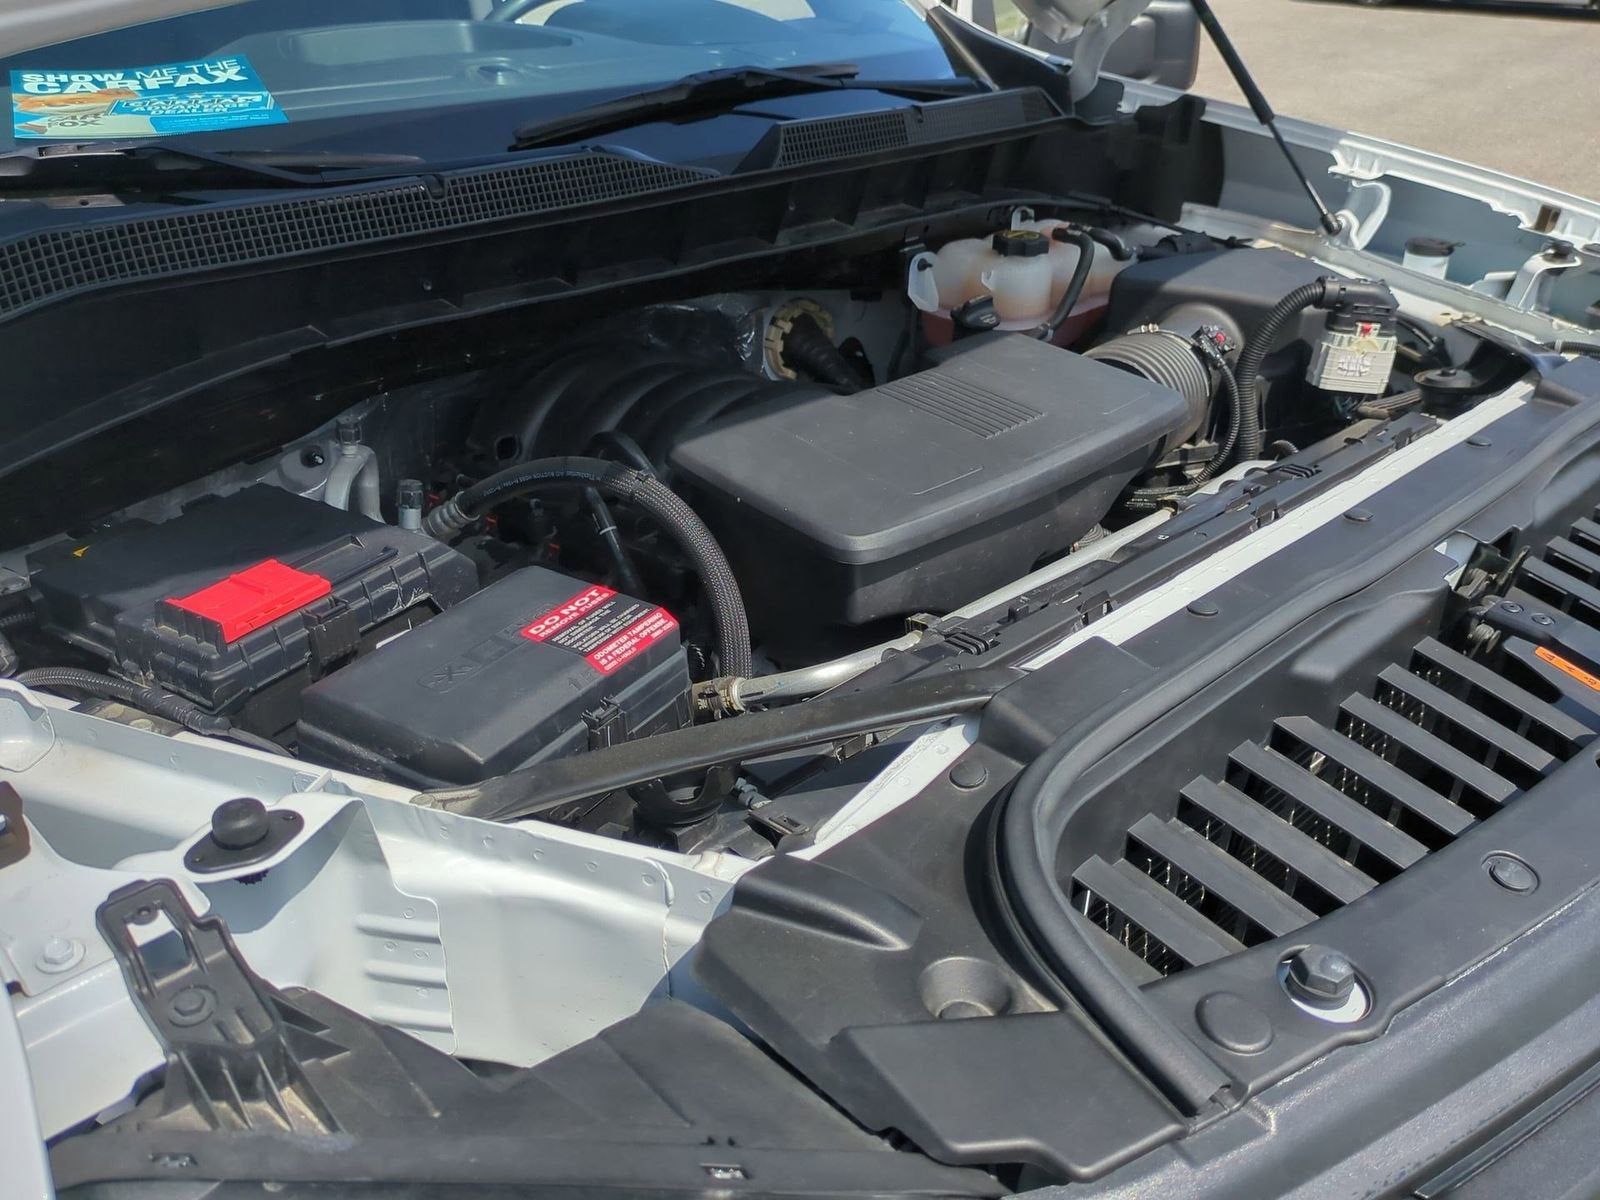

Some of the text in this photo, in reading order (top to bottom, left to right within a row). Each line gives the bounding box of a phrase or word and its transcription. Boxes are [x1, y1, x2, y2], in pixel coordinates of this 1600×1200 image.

[22, 59, 238, 83] SHOW ME THE
[23, 66, 249, 94] CARFAX
[529, 589, 600, 635] DO NOT
[538, 592, 610, 637] REMOVE FUSES
[592, 634, 630, 660] ODOMETER
[626, 611, 663, 636] TAMPERING
[611, 636, 641, 656] FEDERAL
[637, 617, 667, 638] OFFENSE.
